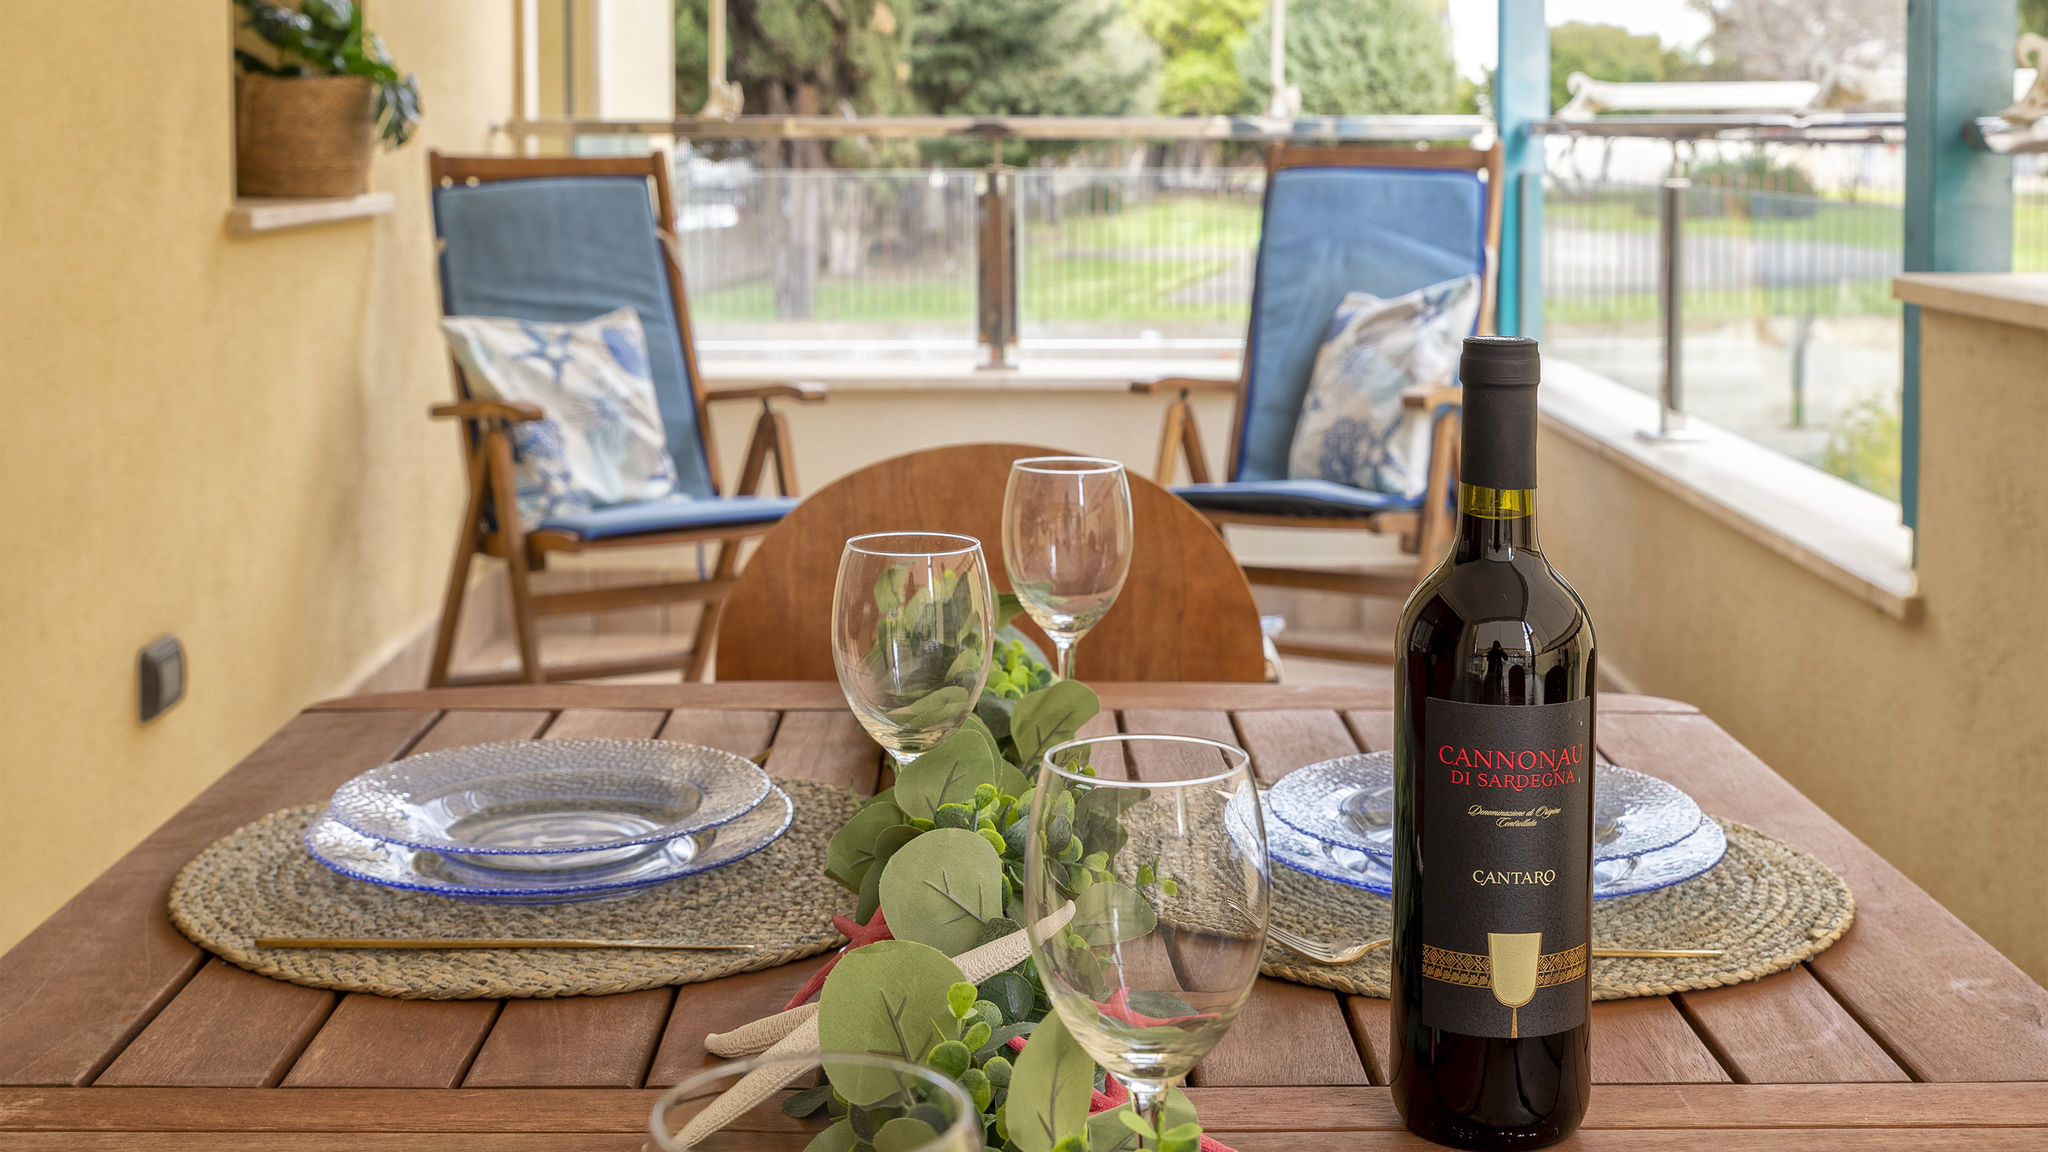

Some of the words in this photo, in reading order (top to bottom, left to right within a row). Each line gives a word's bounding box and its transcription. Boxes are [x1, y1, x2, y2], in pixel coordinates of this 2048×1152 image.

[1439, 744, 1583, 772] CANNONAU
[1451, 770, 1471, 786] DI
[1478, 769, 1576, 792] SARDEGNA
[1468, 804, 1526, 817] Denominazione
[1526, 807, 1536, 817] di
[1535, 805, 1561, 819] Origine
[1496, 817, 1537, 828] Controllata
[1472, 869, 1556, 886] CANTARO
